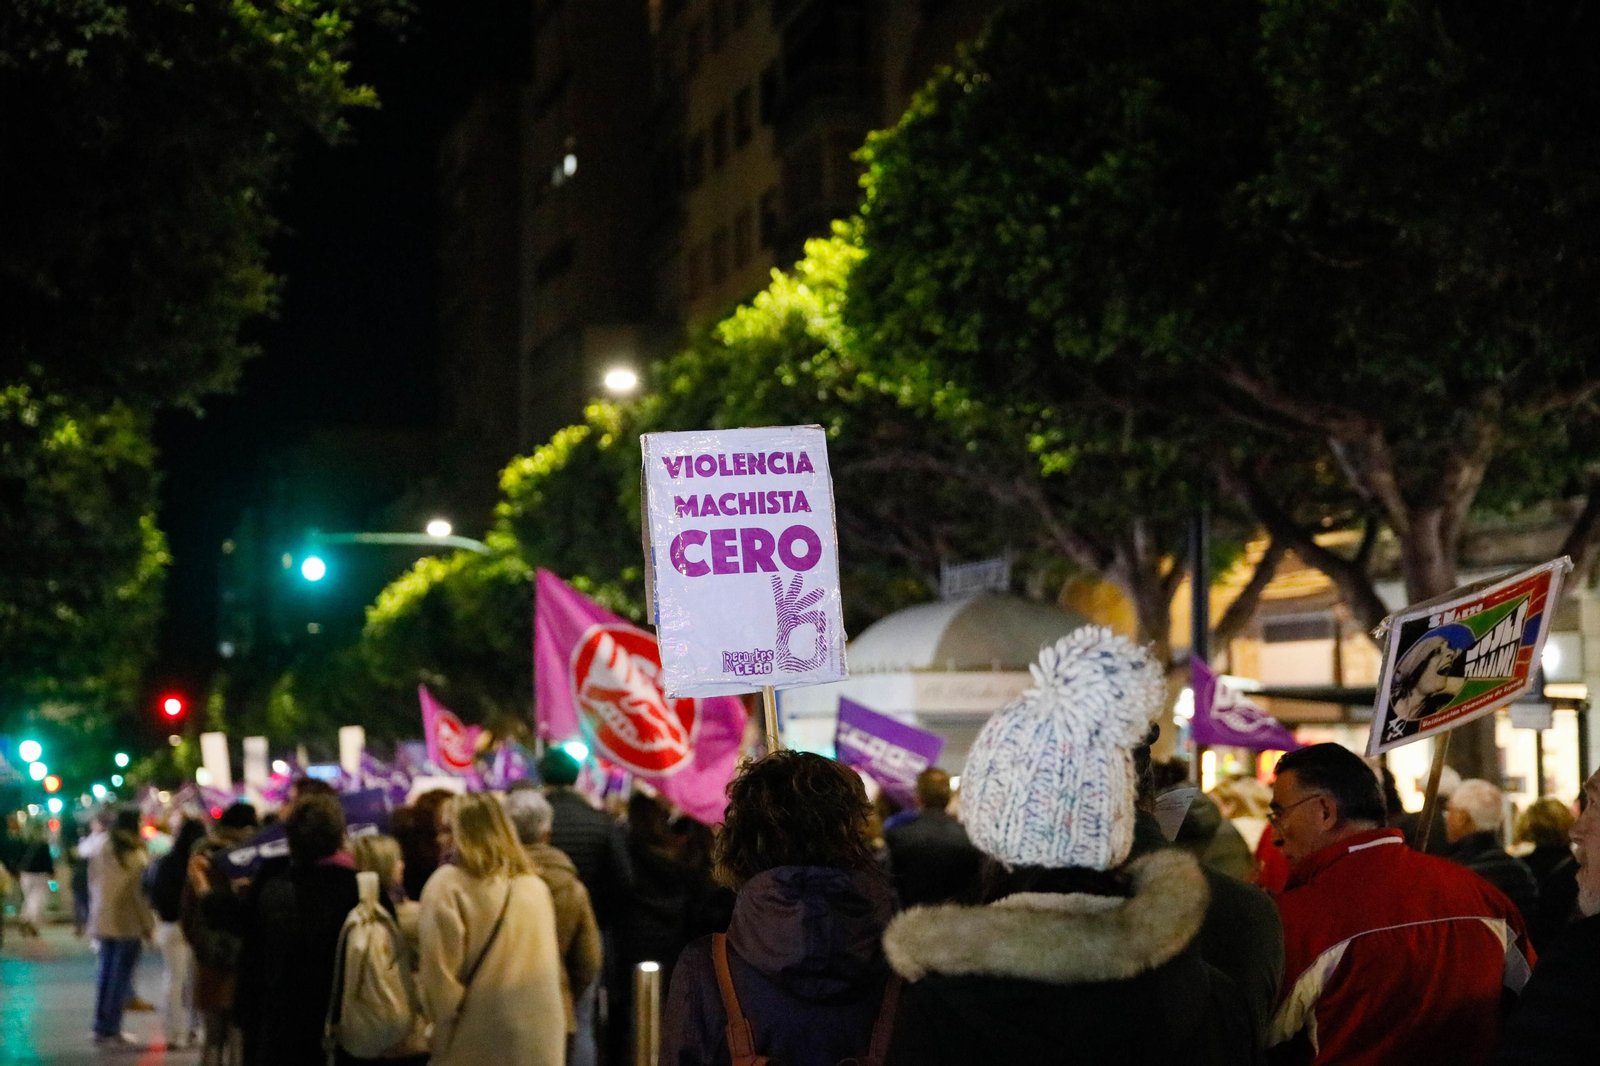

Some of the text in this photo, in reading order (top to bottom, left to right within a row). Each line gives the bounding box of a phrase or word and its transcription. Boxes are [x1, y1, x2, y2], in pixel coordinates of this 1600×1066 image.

[662, 451, 815, 479] VIOLENCIA
[674, 490, 812, 518] MACHISTA
[670, 524, 822, 577] CERO
[722, 648, 774, 672] Recortes
[734, 662, 773, 676] CERO
